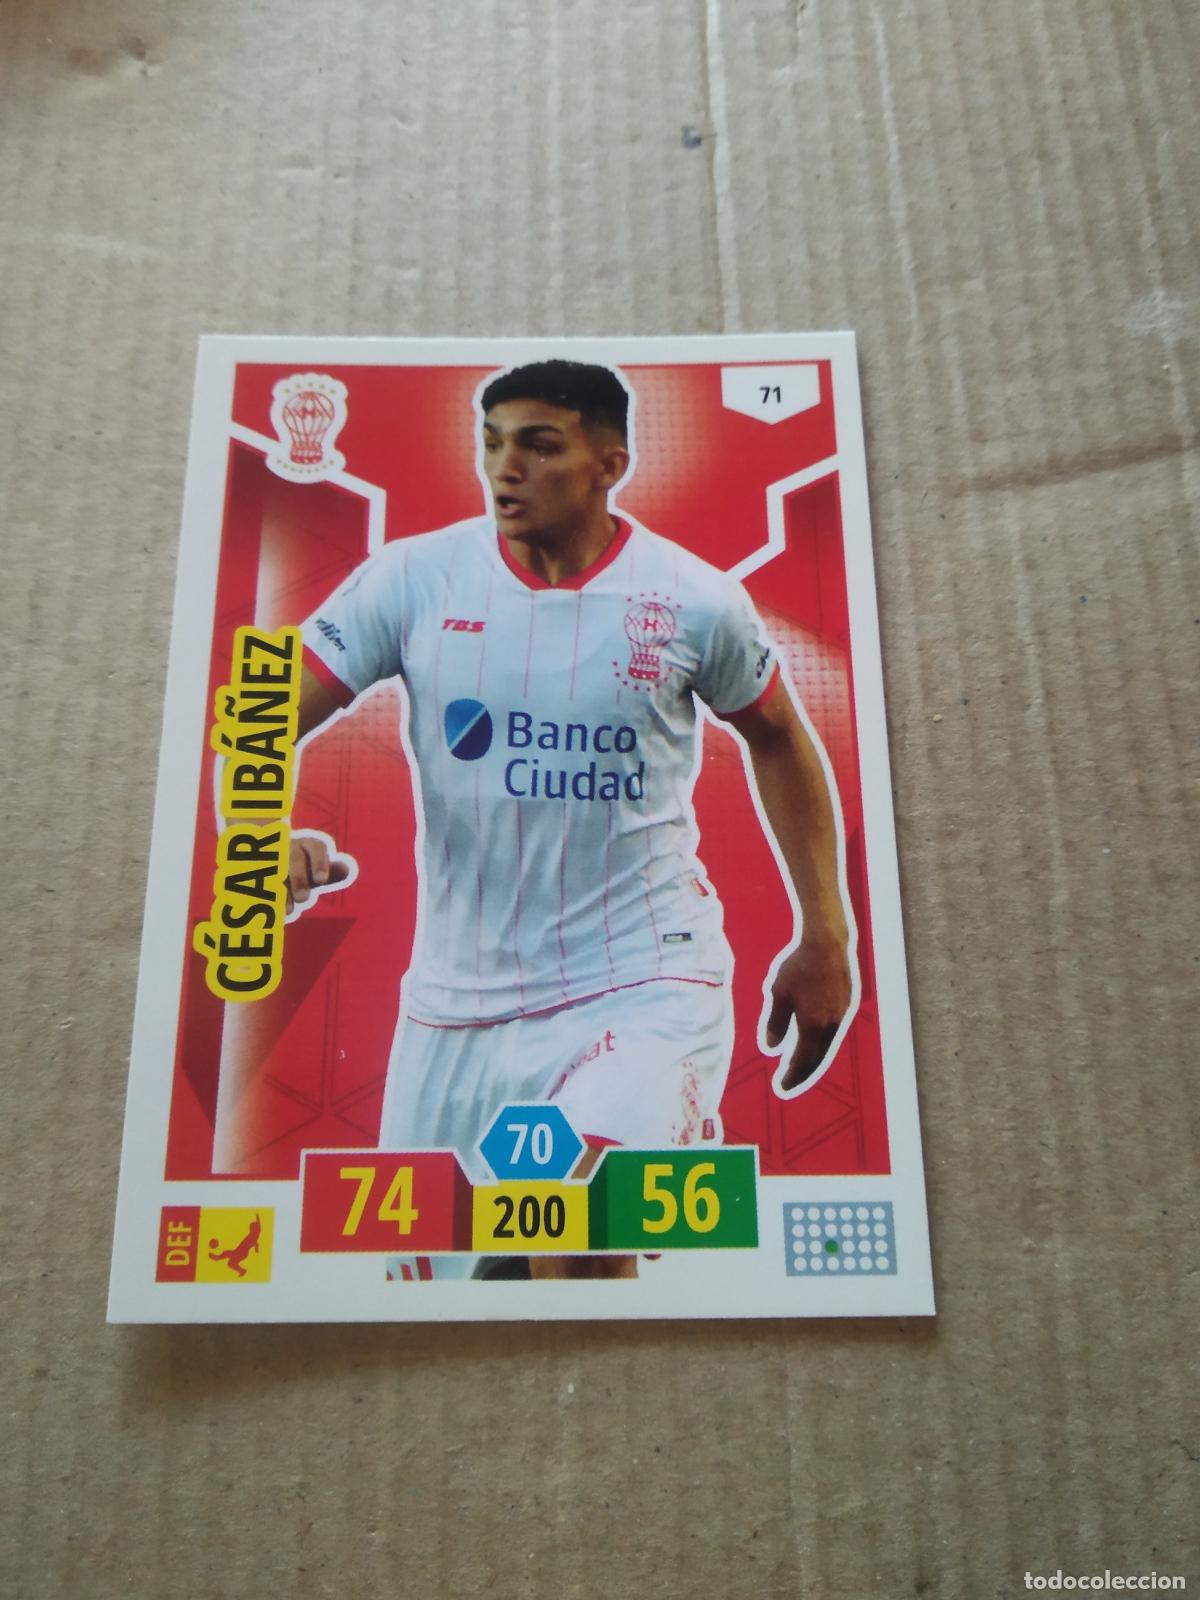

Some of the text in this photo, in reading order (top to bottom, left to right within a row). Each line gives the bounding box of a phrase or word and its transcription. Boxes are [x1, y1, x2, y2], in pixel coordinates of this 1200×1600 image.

[759, 386, 781, 404] 71
[507, 711, 637, 753] Banco
[504, 758, 645, 801] Ciudad
[203, 635, 294, 992] CÉSAR IBÁÑEZ
[506, 1123, 554, 1165] 70
[340, 1166, 418, 1236] 74
[492, 1194, 566, 1238] 200
[642, 1162, 720, 1235] 56
[165, 1221, 193, 1266] DEF
